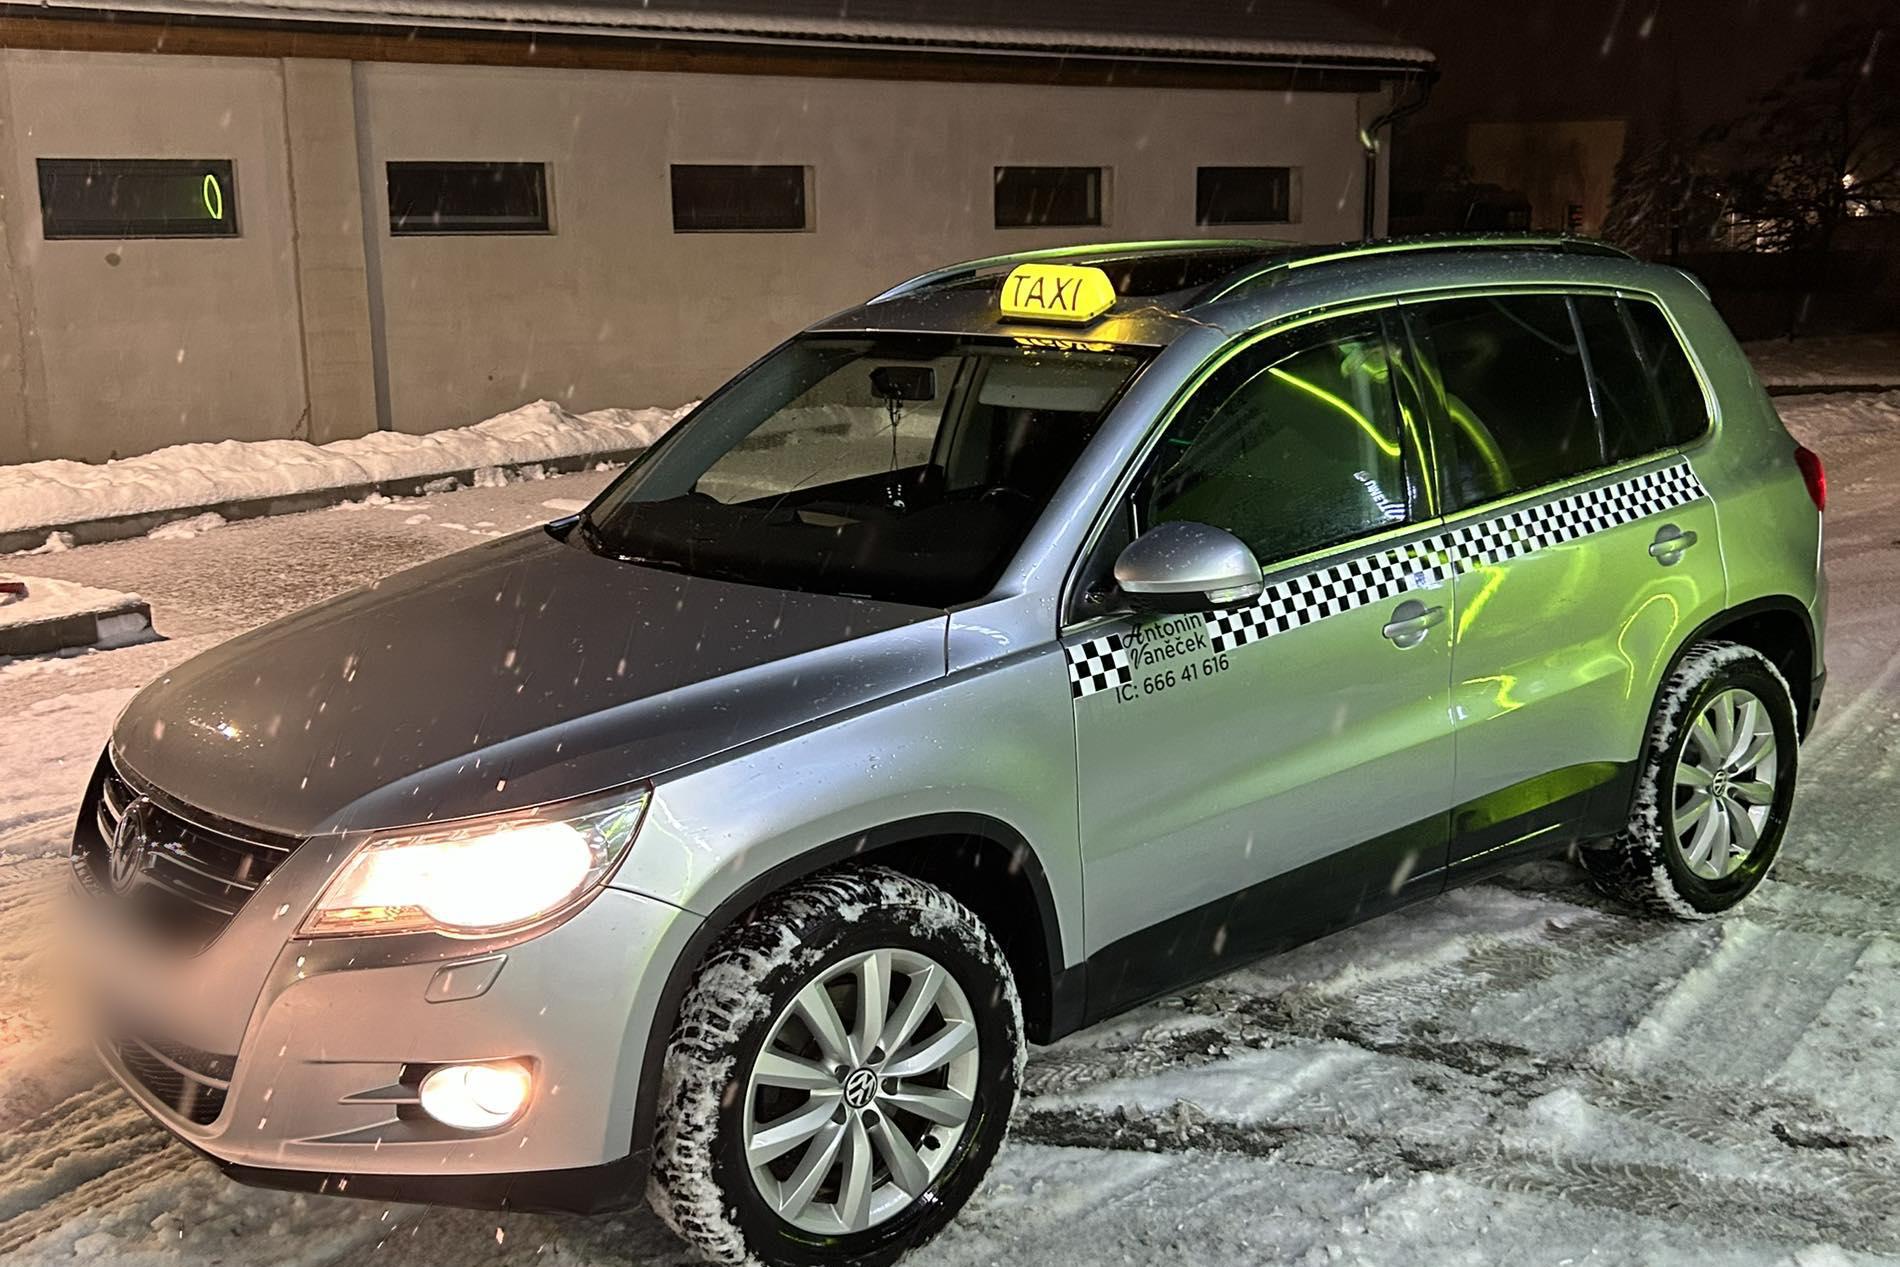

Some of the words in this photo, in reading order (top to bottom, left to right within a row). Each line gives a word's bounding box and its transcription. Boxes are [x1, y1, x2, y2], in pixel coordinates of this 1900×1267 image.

[1014, 275, 1083, 311] TAXI
[1130, 631, 1207, 670] Vaněček
[1143, 670, 1176, 694] 666
[1181, 663, 1198, 682] 41
[1202, 654, 1229, 676] 616
